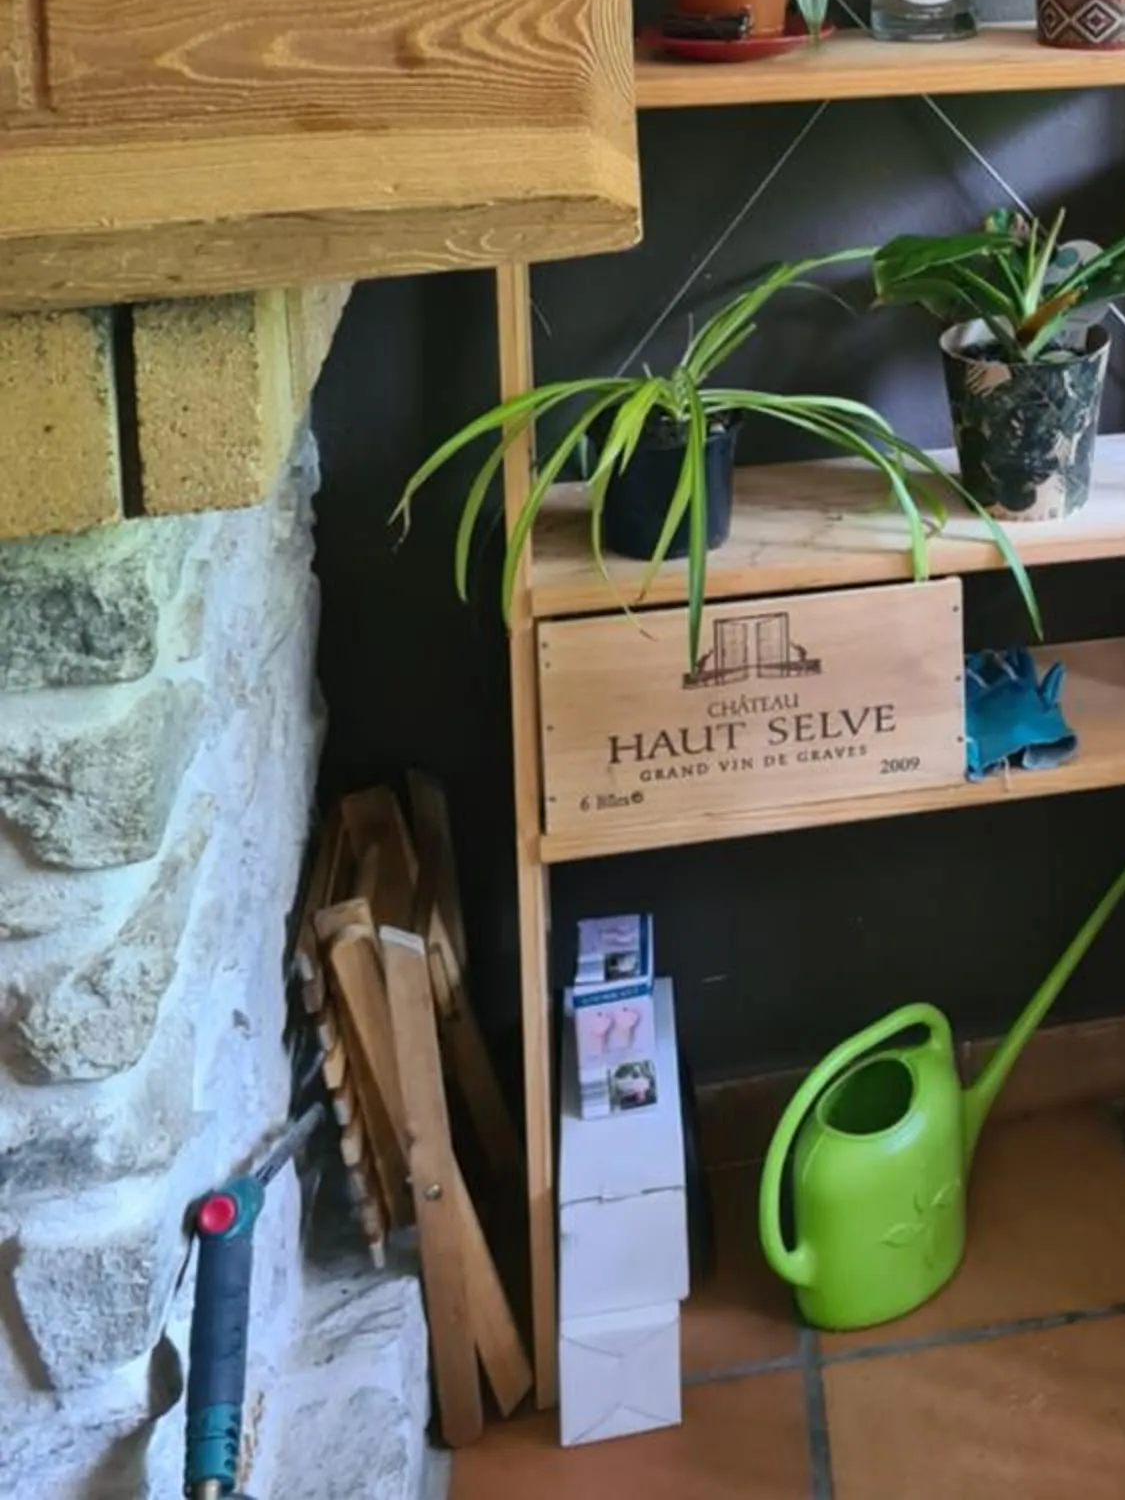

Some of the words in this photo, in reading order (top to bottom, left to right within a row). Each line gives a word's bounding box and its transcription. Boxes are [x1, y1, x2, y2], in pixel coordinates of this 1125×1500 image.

[608, 721, 747, 765] HAUT
[768, 704, 897, 746] SELVE
[639, 762, 709, 783] GRAND
[718, 756, 755, 773] VIN
[763, 752, 789, 769] DE
[797, 744, 868, 763] GRAVES
[879, 757, 921, 776] 2009
